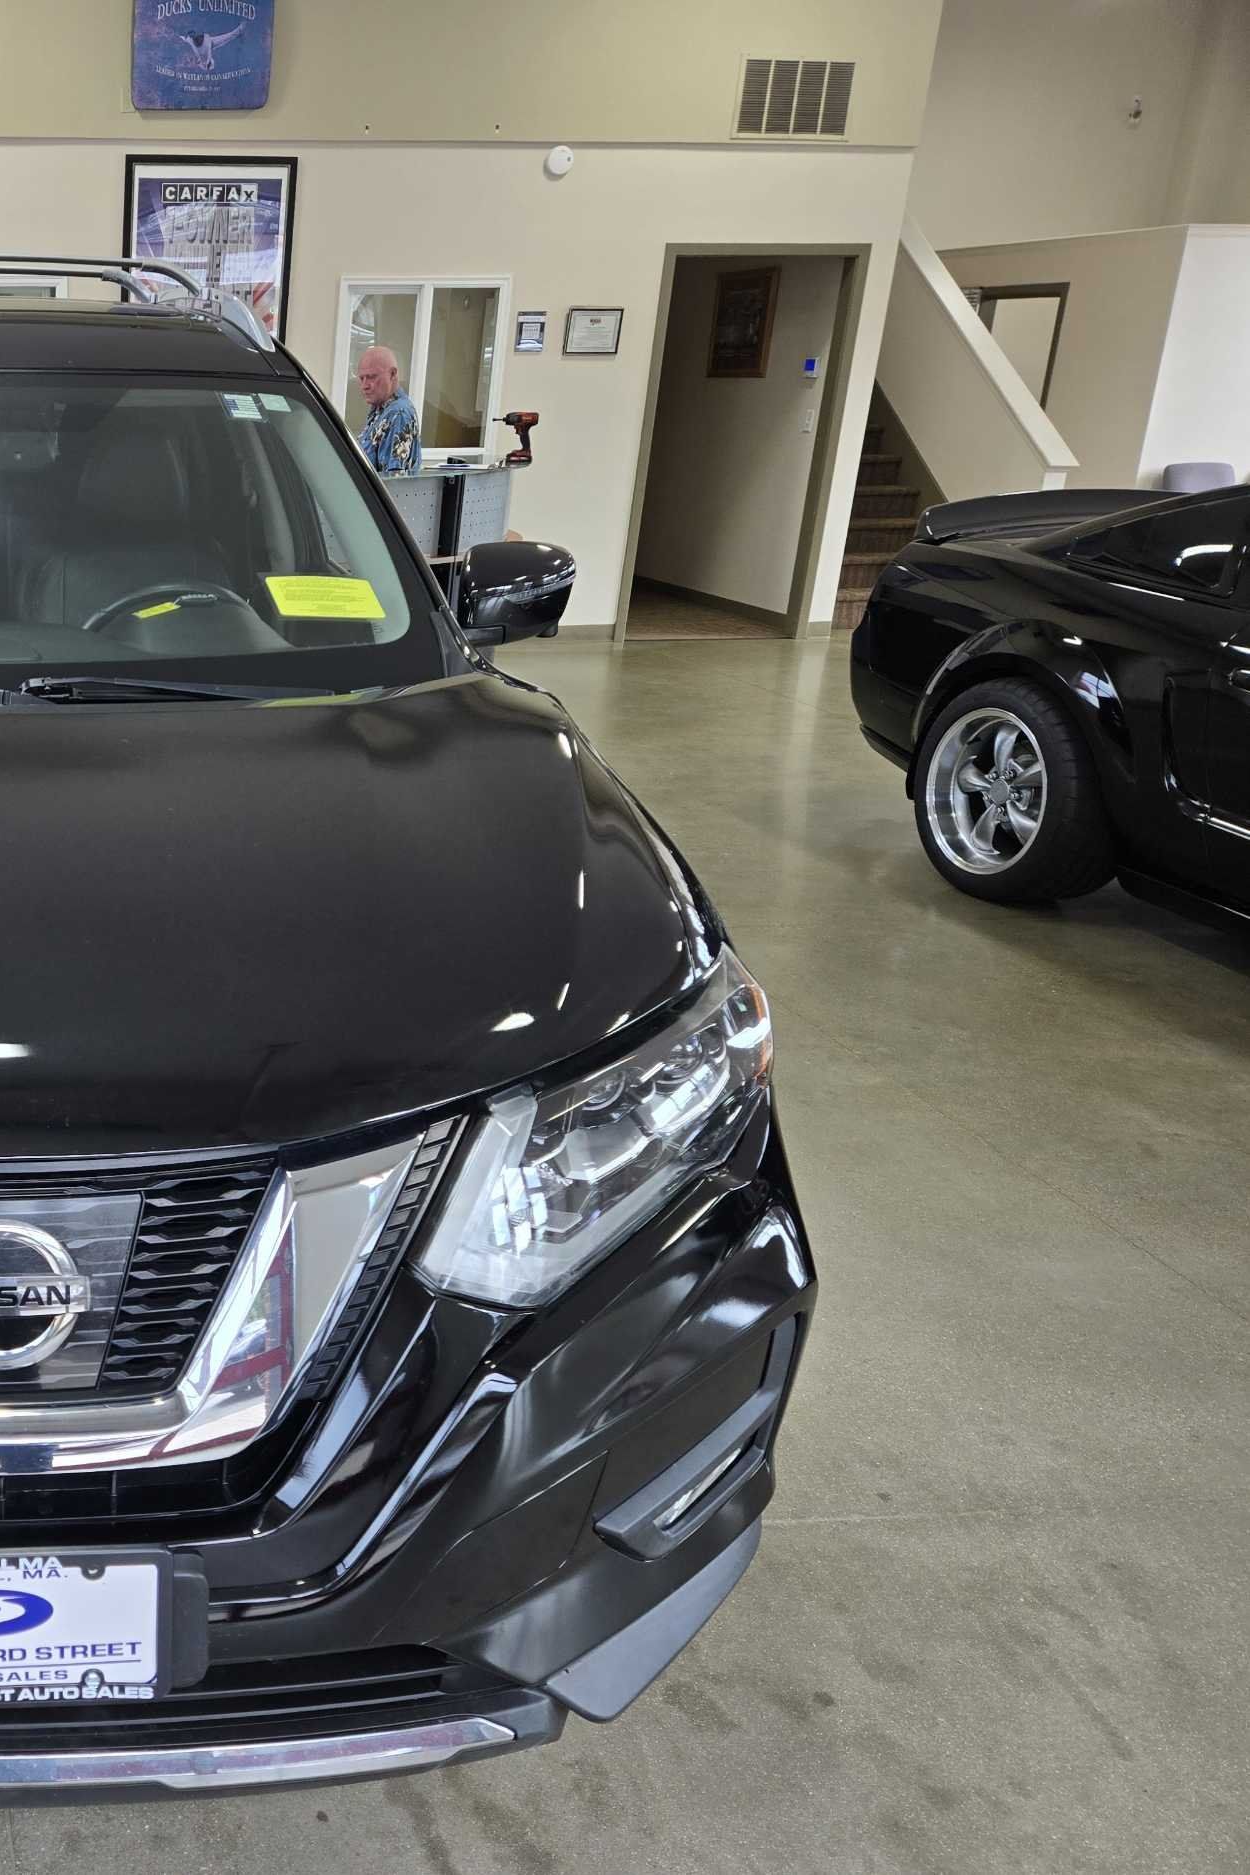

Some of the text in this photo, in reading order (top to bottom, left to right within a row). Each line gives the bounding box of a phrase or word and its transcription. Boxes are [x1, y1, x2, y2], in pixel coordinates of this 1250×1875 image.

[157, 0, 256, 20] DUCKS UNLIMITED
[164, 185, 255, 202] CARFAX
[18, 1556, 63, 1571] MA
[35, 1641, 142, 1661] STREET
[15, 1686, 80, 1701] AUTO
[81, 1684, 155, 1700] SALES
